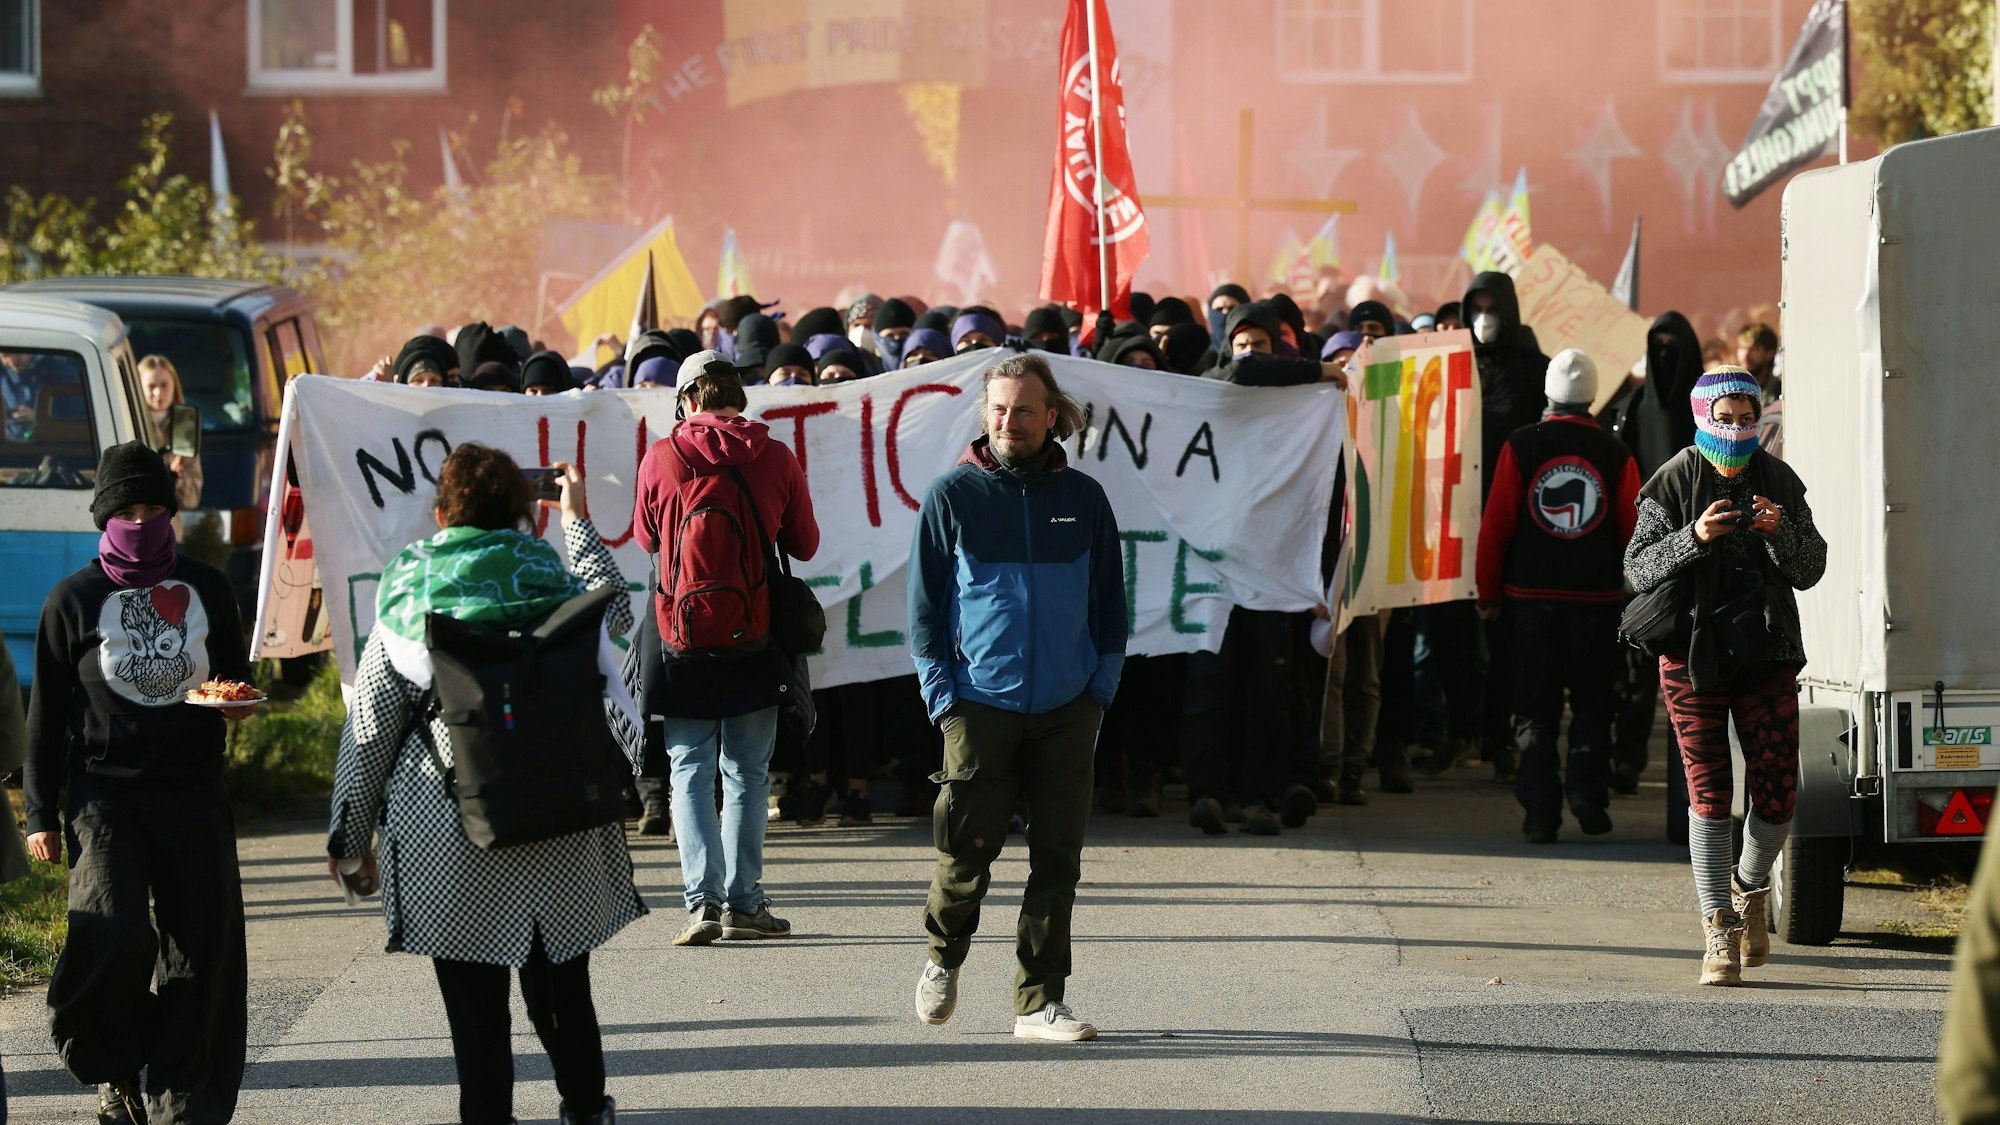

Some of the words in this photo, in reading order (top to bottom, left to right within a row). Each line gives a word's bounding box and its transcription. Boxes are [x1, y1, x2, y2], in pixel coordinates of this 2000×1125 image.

[356, 428, 452, 510] NO
[535, 383, 961, 548] JUTIC
[1078, 401, 1152, 470] IN
[1176, 421, 1220, 483] A
